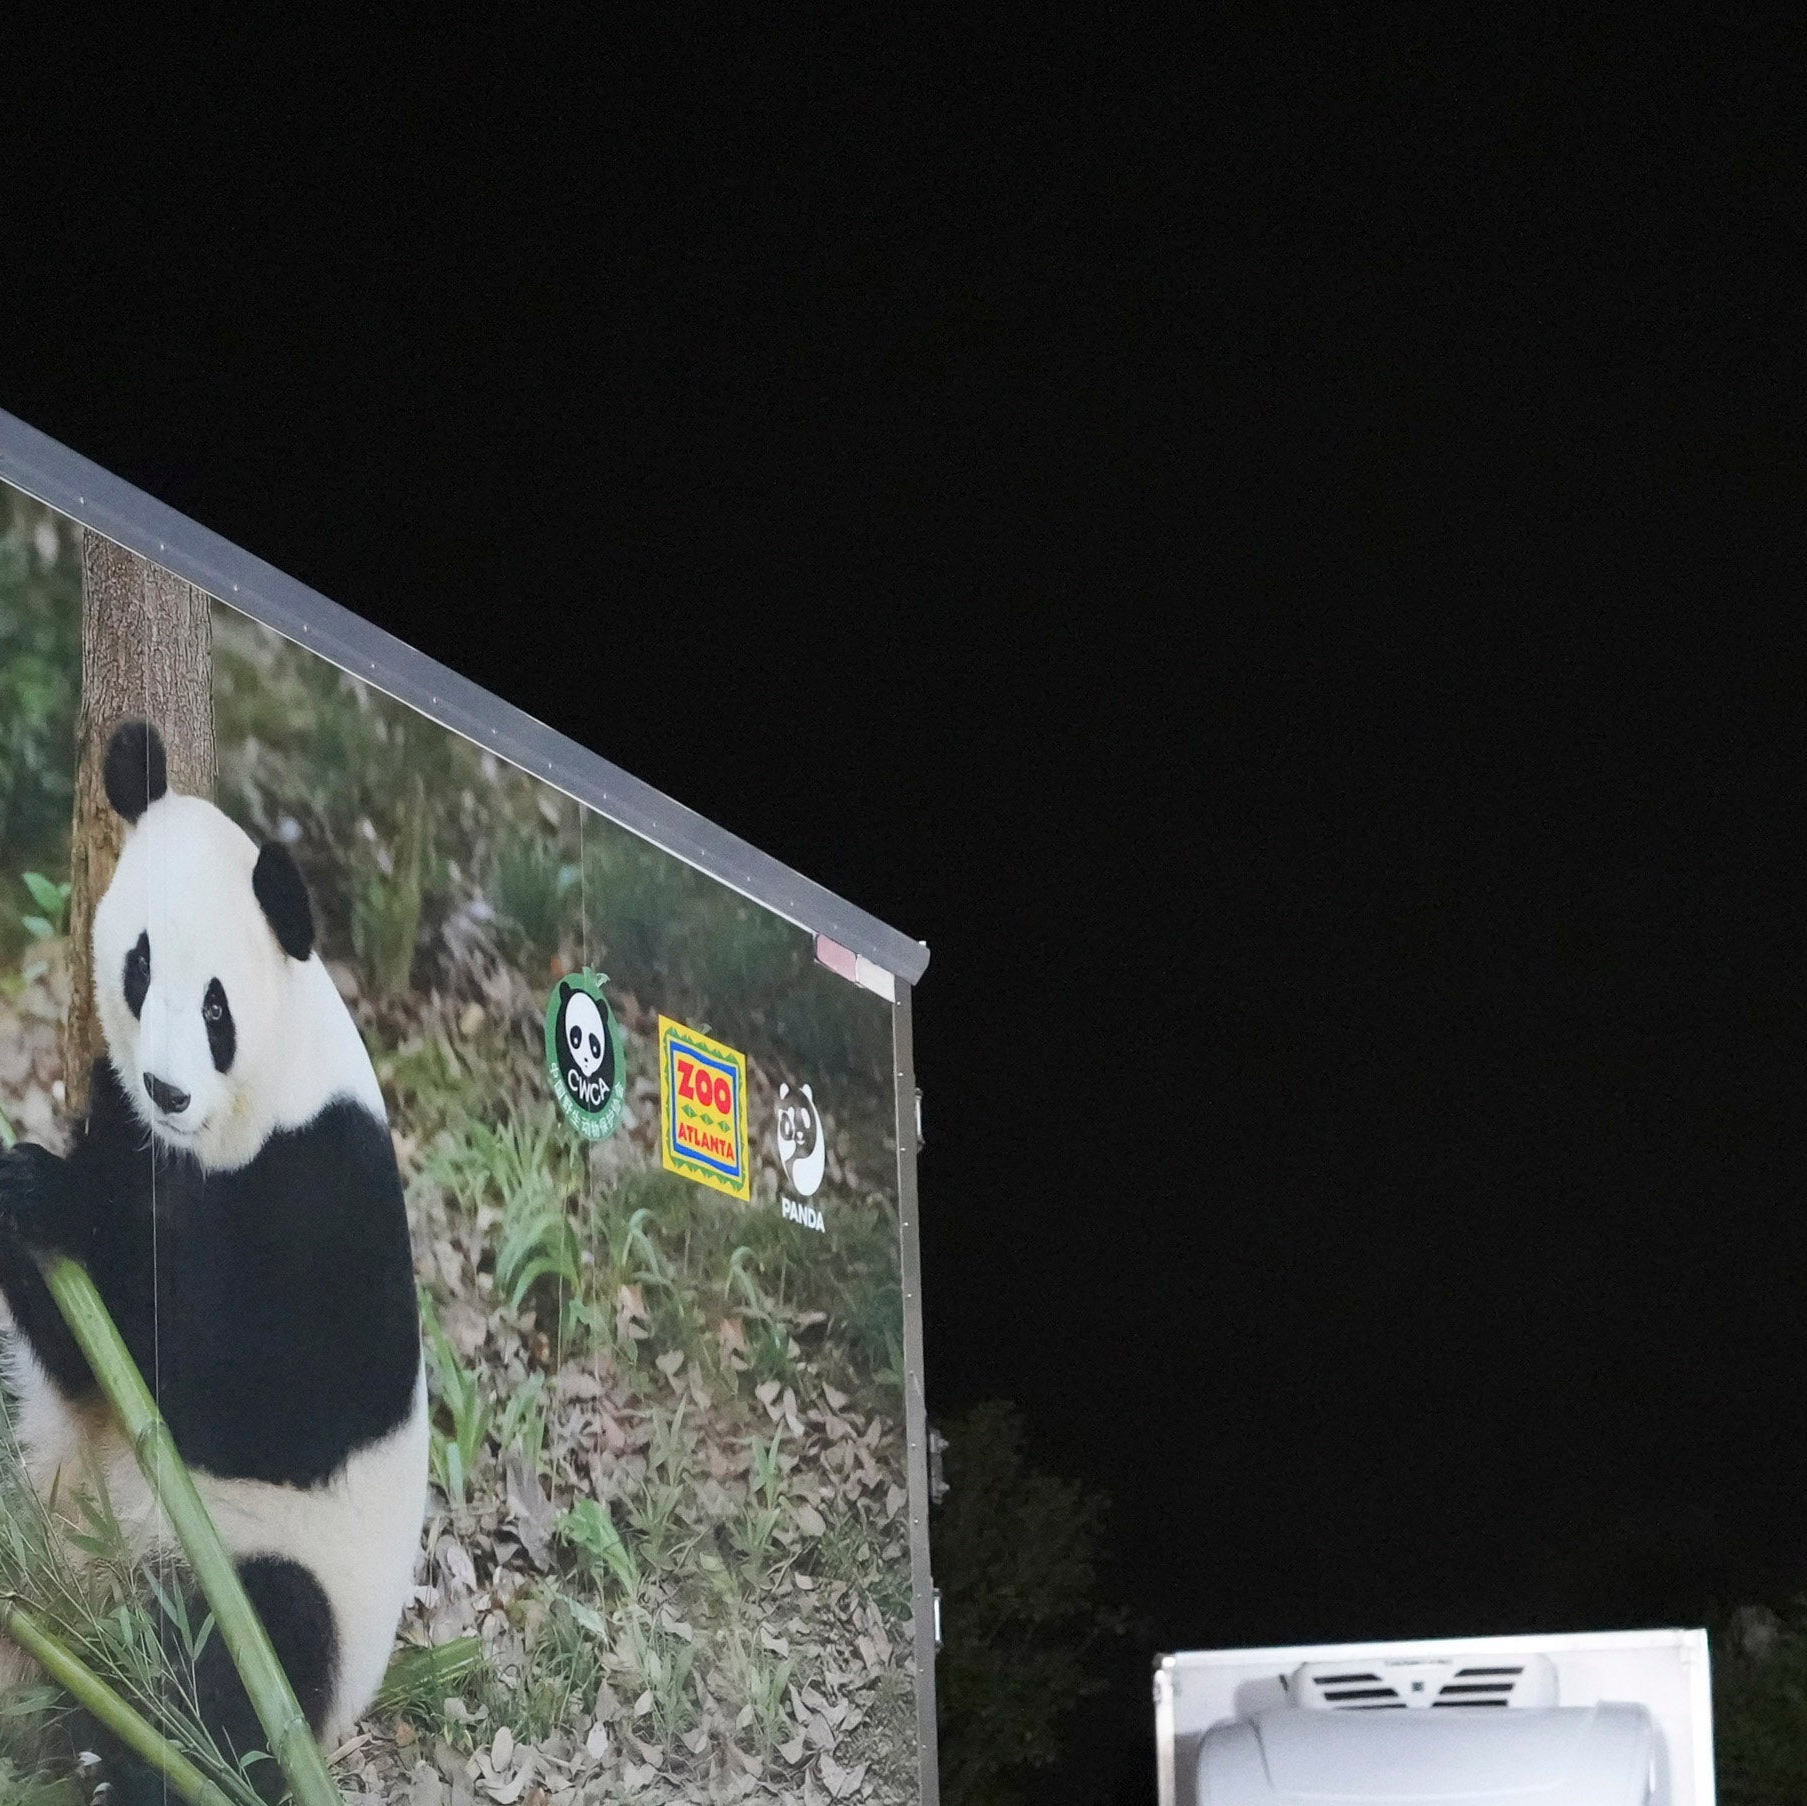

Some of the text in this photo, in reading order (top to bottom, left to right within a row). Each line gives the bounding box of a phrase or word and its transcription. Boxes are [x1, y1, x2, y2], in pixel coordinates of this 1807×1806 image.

[567, 1069, 610, 1106] CWCA
[676, 1059, 732, 1116] ZOO
[677, 1122, 735, 1161] ATLANTA
[781, 1197, 825, 1234] PANDA
